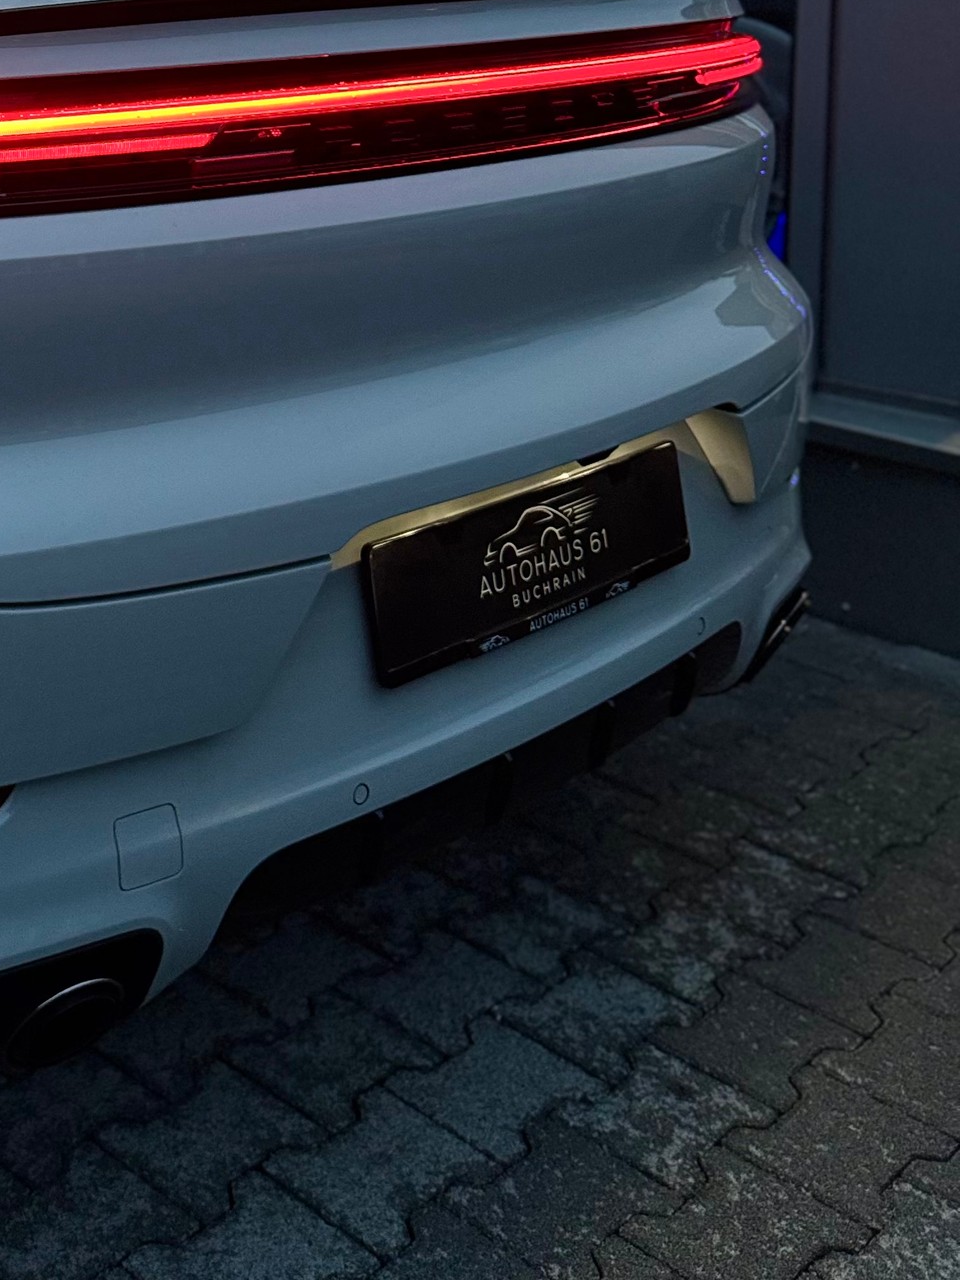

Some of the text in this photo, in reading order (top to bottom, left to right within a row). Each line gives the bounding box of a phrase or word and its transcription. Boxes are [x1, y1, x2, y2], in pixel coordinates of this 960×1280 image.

[480, 528, 609, 599] AUTOHAUS 61
[512, 566, 587, 608] BUCHRAIN
[529, 597, 589, 632] AUTOHAUS 61
